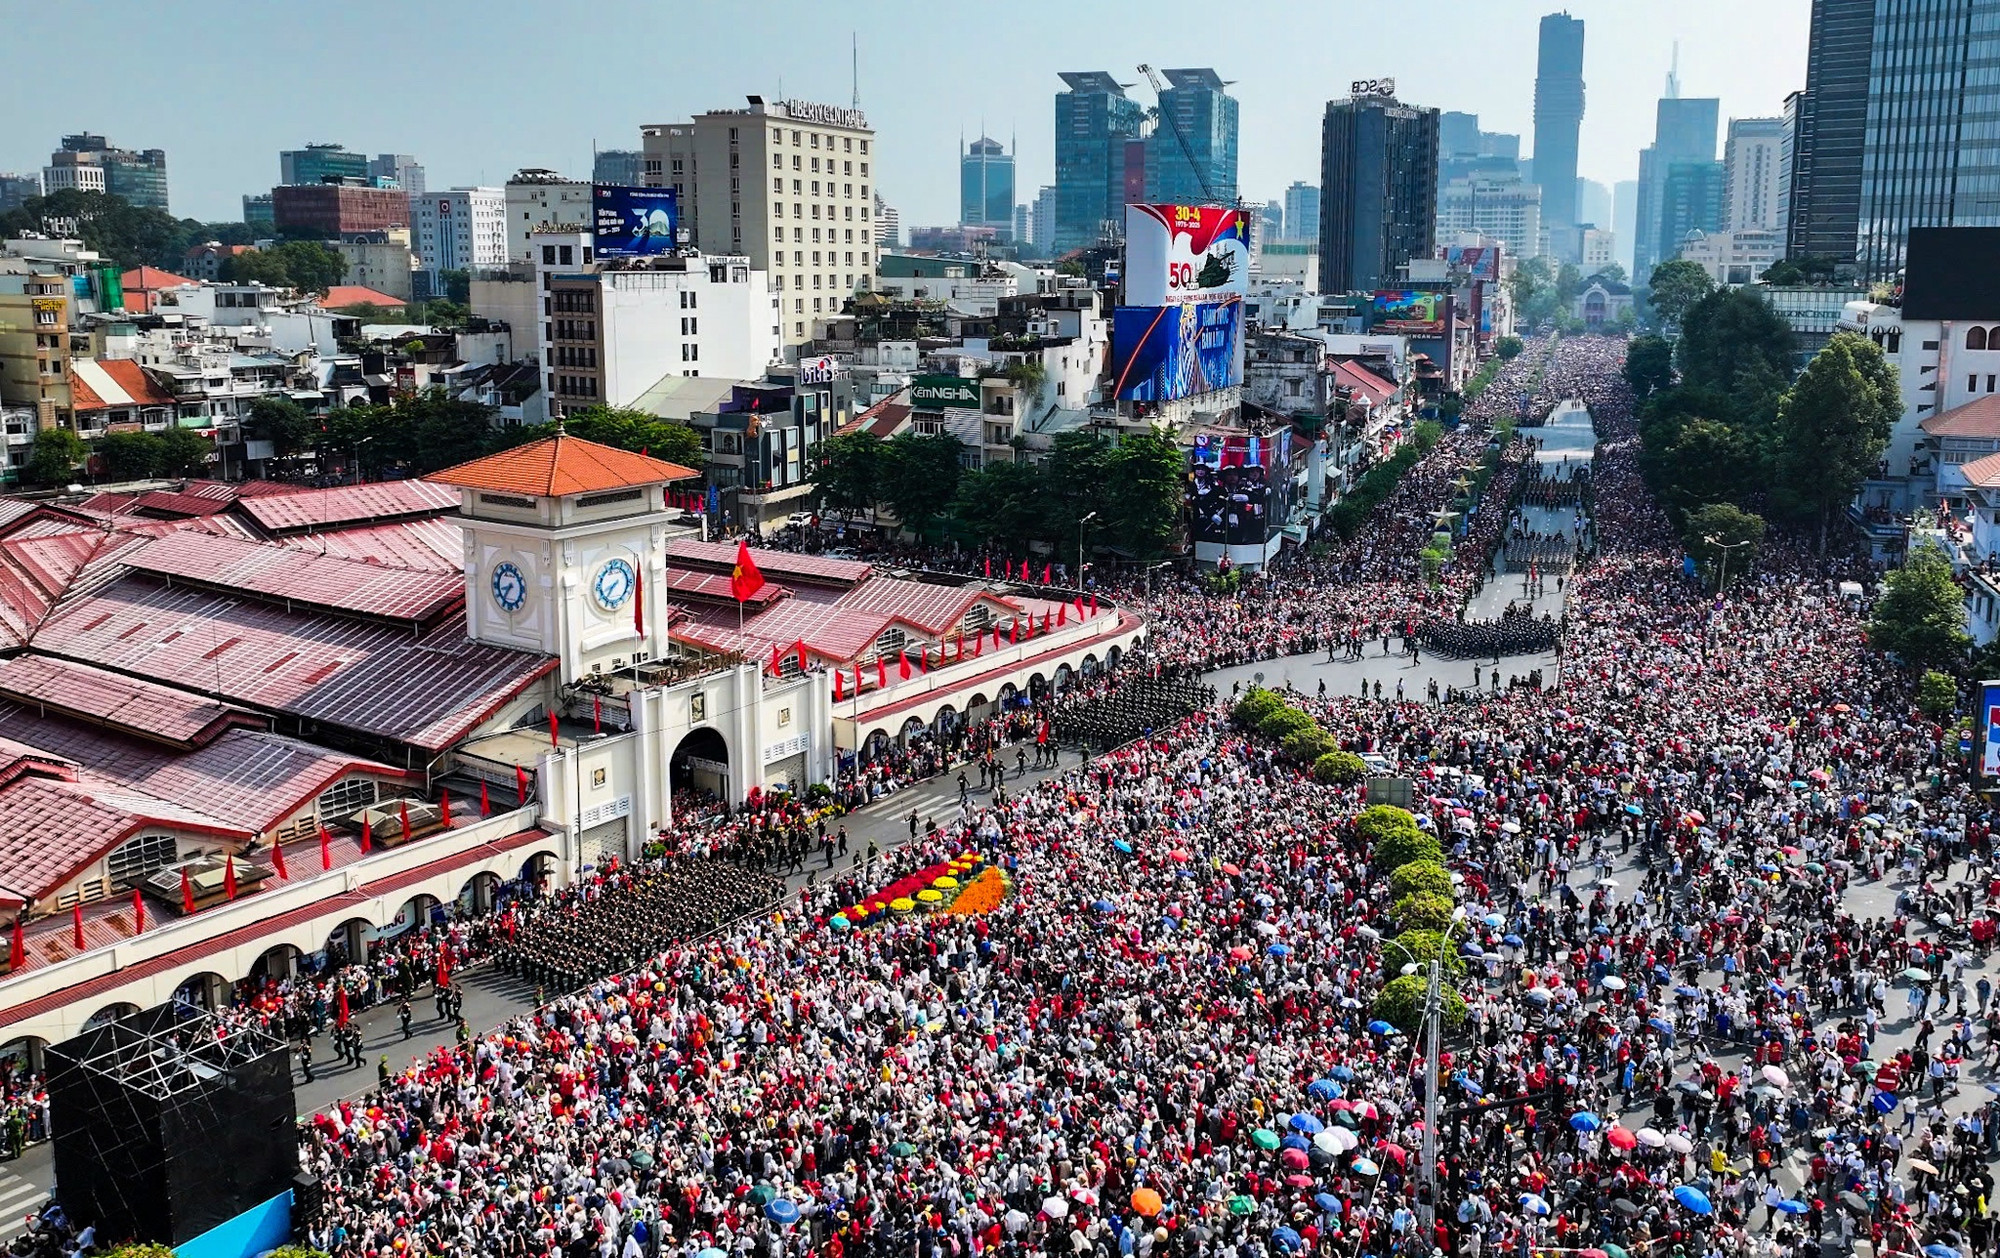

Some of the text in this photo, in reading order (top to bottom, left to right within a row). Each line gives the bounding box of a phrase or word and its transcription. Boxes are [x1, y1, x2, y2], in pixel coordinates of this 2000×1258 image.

[790, 99, 823, 121] LIBERTY
[1175, 206, 1201, 222] 30-4
[1169, 262, 1191, 288] 50
[932, 385, 978, 401] NGHĨA
